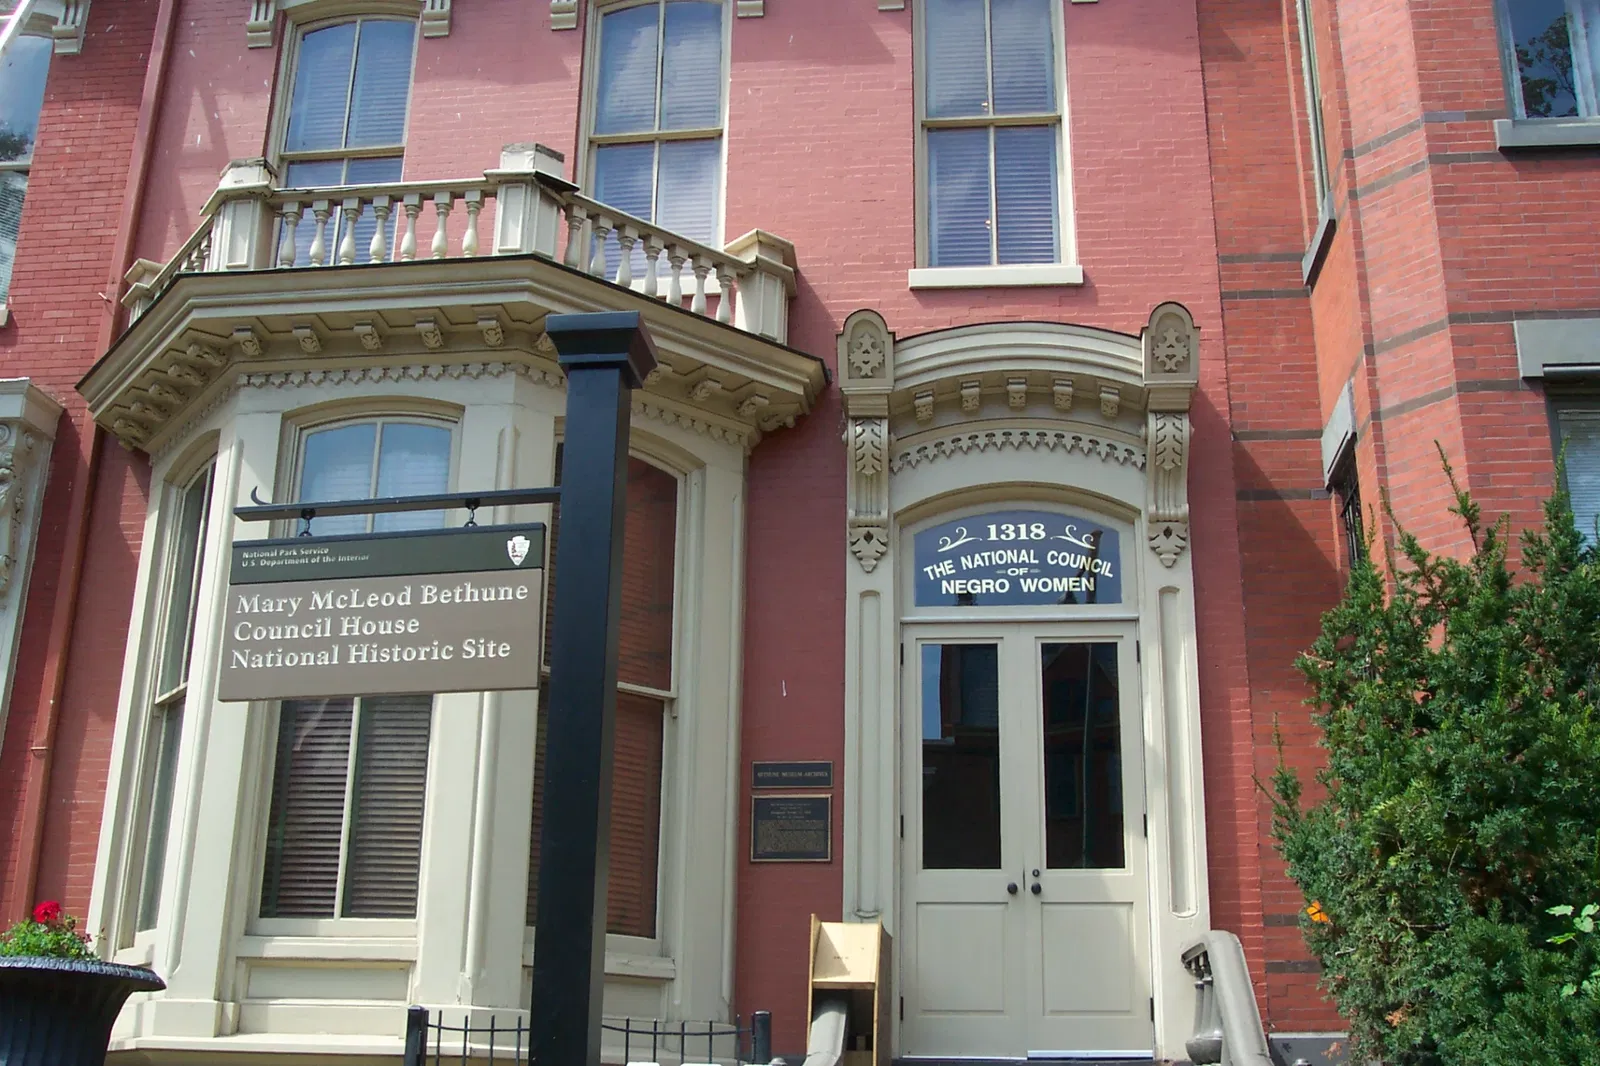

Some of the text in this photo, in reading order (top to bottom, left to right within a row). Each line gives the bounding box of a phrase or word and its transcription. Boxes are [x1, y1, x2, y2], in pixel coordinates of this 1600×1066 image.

[987, 523, 1046, 541] 1318
[243, 549, 277, 558] National
[300, 547, 329, 555] Service
[260, 559, 309, 567] Department
[923, 549, 1114, 580] THE NATIONAL COUNCIL
[1007, 568, 1030, 576] OF
[942, 577, 1095, 594] NEGRO WOMEN
[235, 582, 529, 616] Mary McLeod Bethune
[233, 616, 420, 641] Council House
[230, 638, 511, 669] National Historic Site
